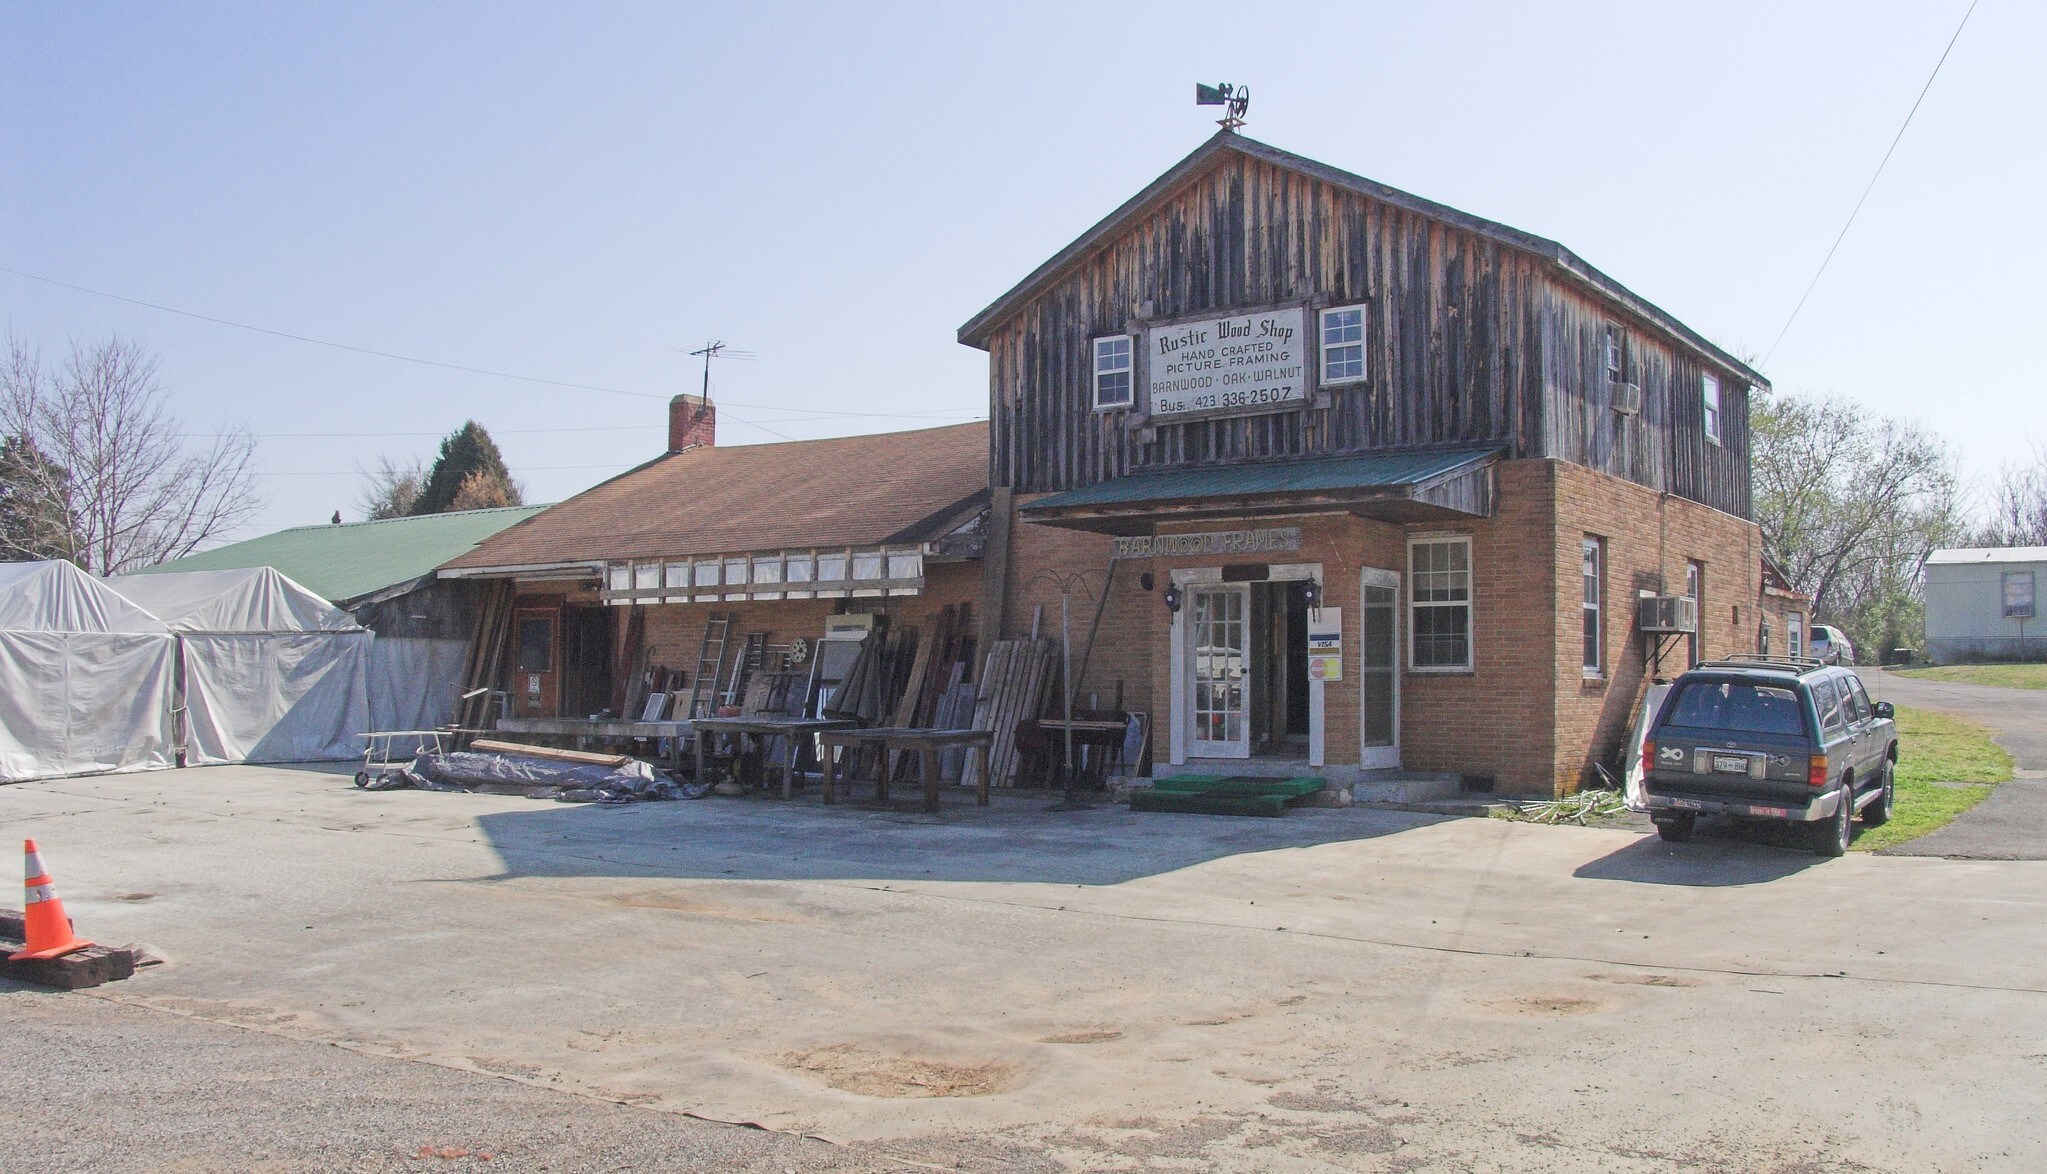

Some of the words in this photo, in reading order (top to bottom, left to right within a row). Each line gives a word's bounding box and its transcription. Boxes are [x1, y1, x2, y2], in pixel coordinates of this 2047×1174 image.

[1160, 329, 1207, 355] Rustic
[1218, 320, 1251, 340] Wood
[1256, 319, 1293, 345] Shop
[1166, 360, 1221, 374] PICTURE
[1229, 351, 1290, 367] FRAMING
[1181, 349, 1215, 361] HAND
[1221, 342, 1273, 357] CRAFTED
[1152, 377, 1212, 394] BARNWOOD
[1222, 372, 1247, 386] OAK
[1253, 366, 1302, 382] WALNUT
[1160, 398, 1186, 413] Bus.
[1195, 395, 1216, 408] 423
[1222, 386, 1292, 407] 336-2507
[1118, 534, 1214, 556] BARNWOOD
[1223, 528, 1291, 551] FRAMES
